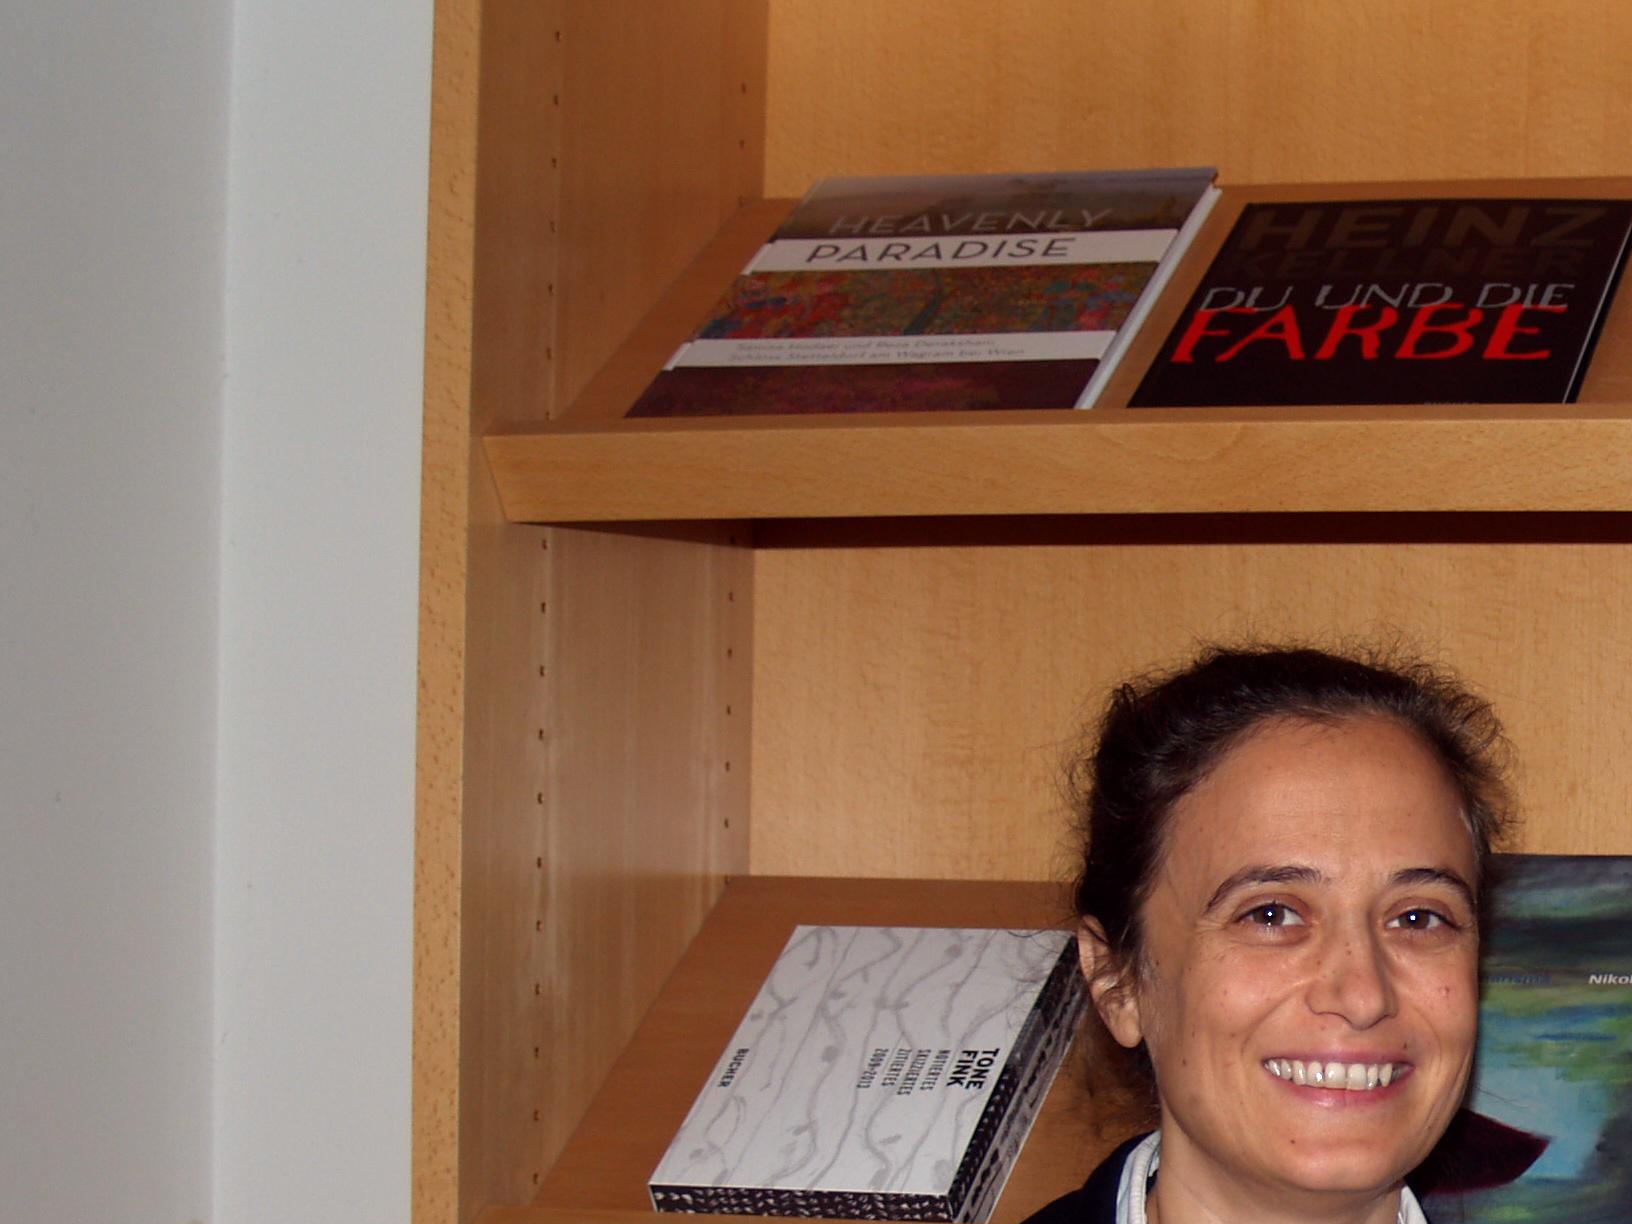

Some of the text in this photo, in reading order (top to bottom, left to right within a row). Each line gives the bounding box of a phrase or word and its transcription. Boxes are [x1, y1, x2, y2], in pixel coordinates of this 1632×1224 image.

[828, 208, 1112, 234] HEAVENLY
[1239, 206, 1607, 251] HEINZ
[805, 236, 1077, 263] PARADISE
[1200, 283, 1575, 312] DU UND DIE
[1170, 304, 1568, 362] FARBE
[718, 1048, 750, 1088] BUCHER
[881, 1048, 912, 1087] ZITIERTES
[920, 1049, 951, 1090] NOTIERTES
[946, 1050, 979, 1087] FINK
[964, 1047, 1000, 1090] TONE
